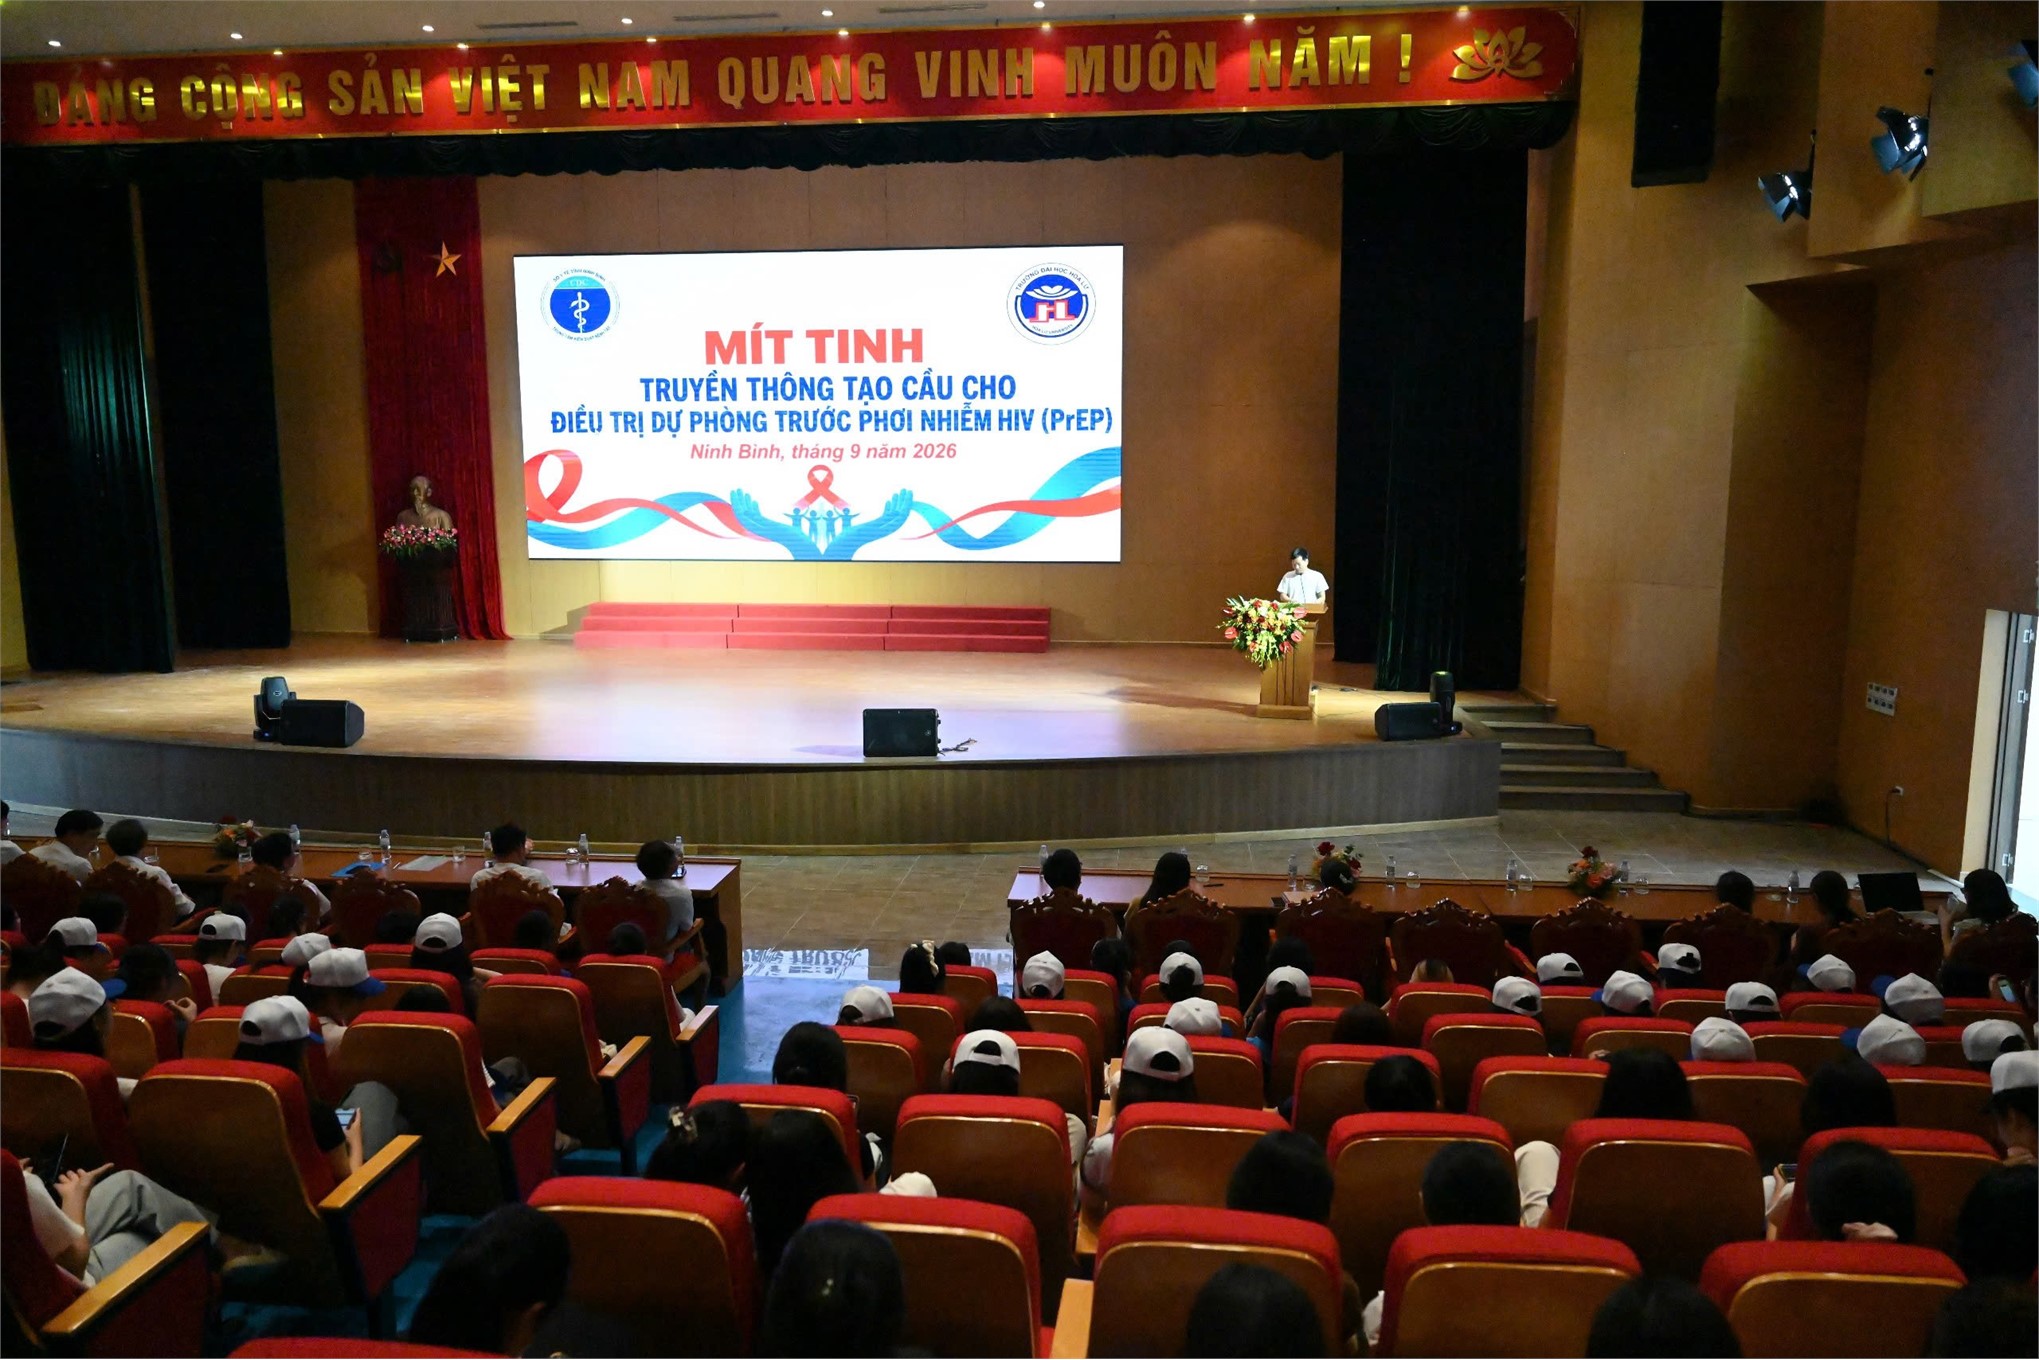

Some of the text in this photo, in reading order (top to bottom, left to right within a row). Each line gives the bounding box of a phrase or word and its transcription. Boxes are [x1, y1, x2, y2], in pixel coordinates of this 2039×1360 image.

[181, 63, 304, 130] CỘNG
[328, 53, 423, 115] SẢN
[449, 54, 549, 122] VIỆT
[579, 60, 690, 109] NAM
[718, 52, 886, 109] QUANG
[915, 47, 1034, 98] VINH
[1065, 30, 1217, 95] MUÔN
[1249, 26, 1371, 88] NĂM
[1399, 34, 1412, 83] !
[705, 322, 923, 364] MÍT TINH
[640, 368, 1016, 405] TRUYỀN THÔNG TẠO CẦU CHO
[551, 402, 1113, 438] ĐIỀU TRỊ DỰ PHÒNG TRƯỚC PHƠI NHIỄM HIV (PrEP)
[690, 444, 732, 459] Ninh
[792, 444, 844, 462] tháng
[850, 444, 861, 459] 9
[866, 443, 906, 459] năm
[913, 443, 957, 459] 2026
